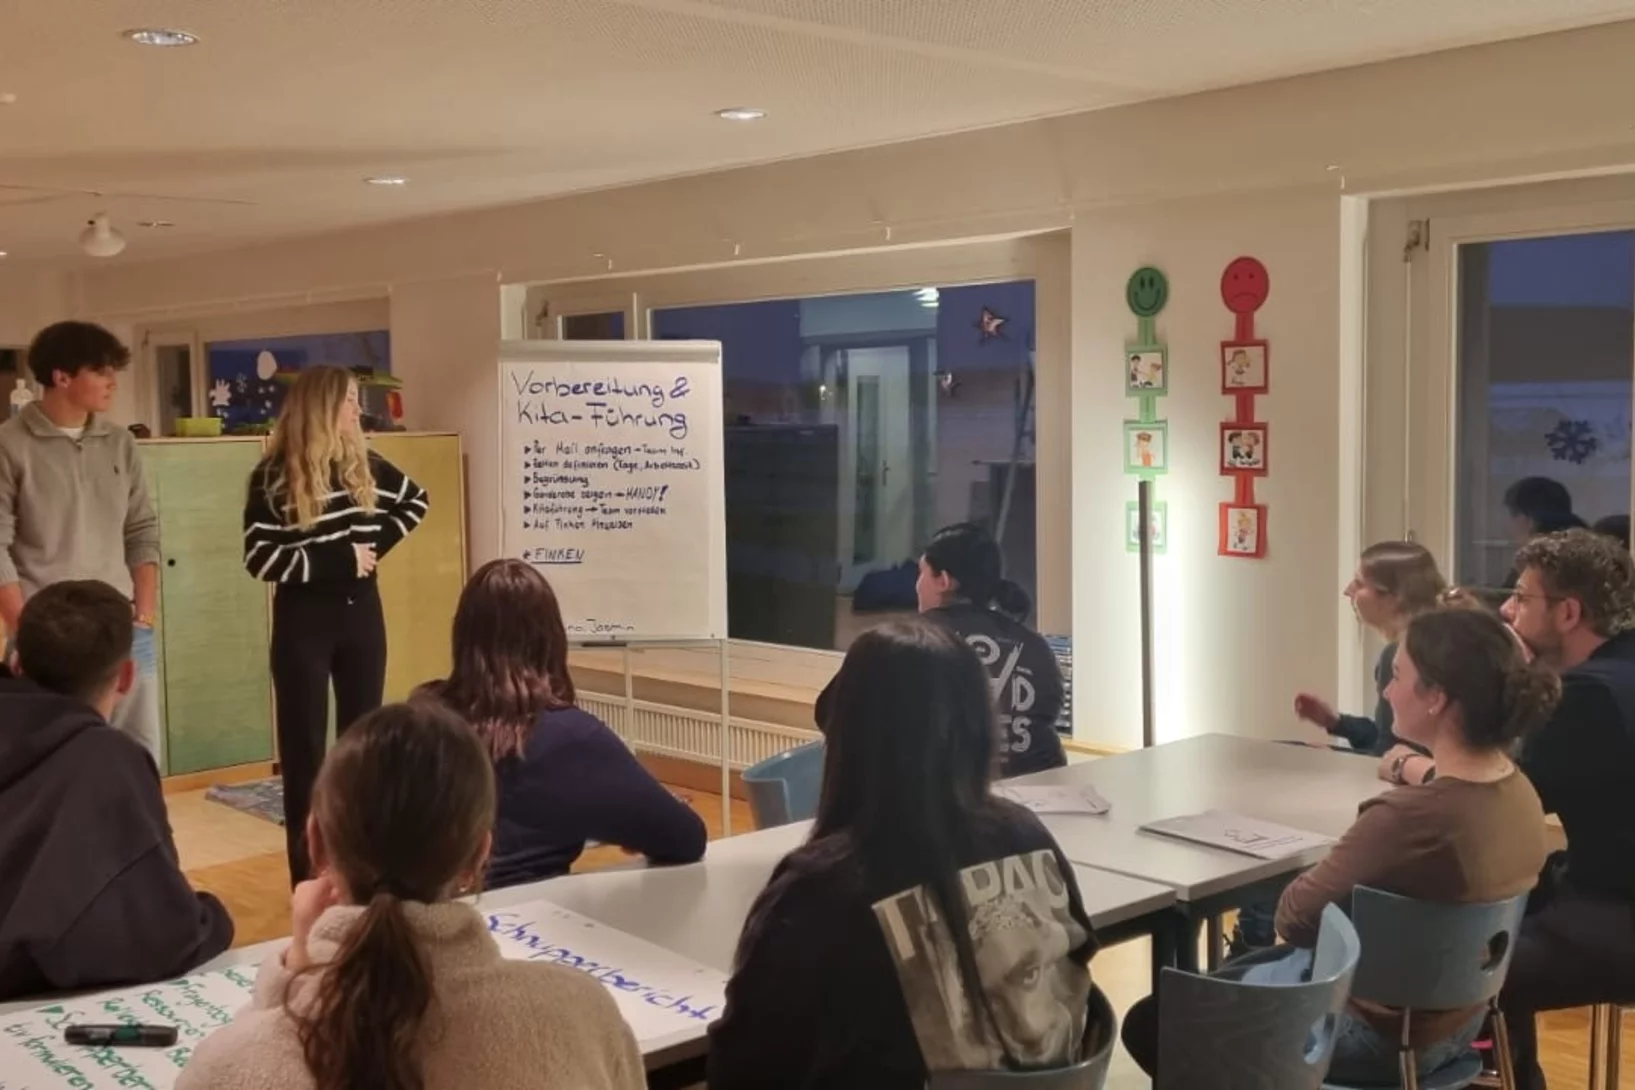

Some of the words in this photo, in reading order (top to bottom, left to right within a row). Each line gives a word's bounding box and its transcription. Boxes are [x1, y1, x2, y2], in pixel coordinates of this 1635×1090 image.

[511, 370, 664, 408] Vorbereitung
[669, 376, 690, 399] &
[584, 443, 631, 459] anfragen
[534, 547, 585, 561] FINKEN
